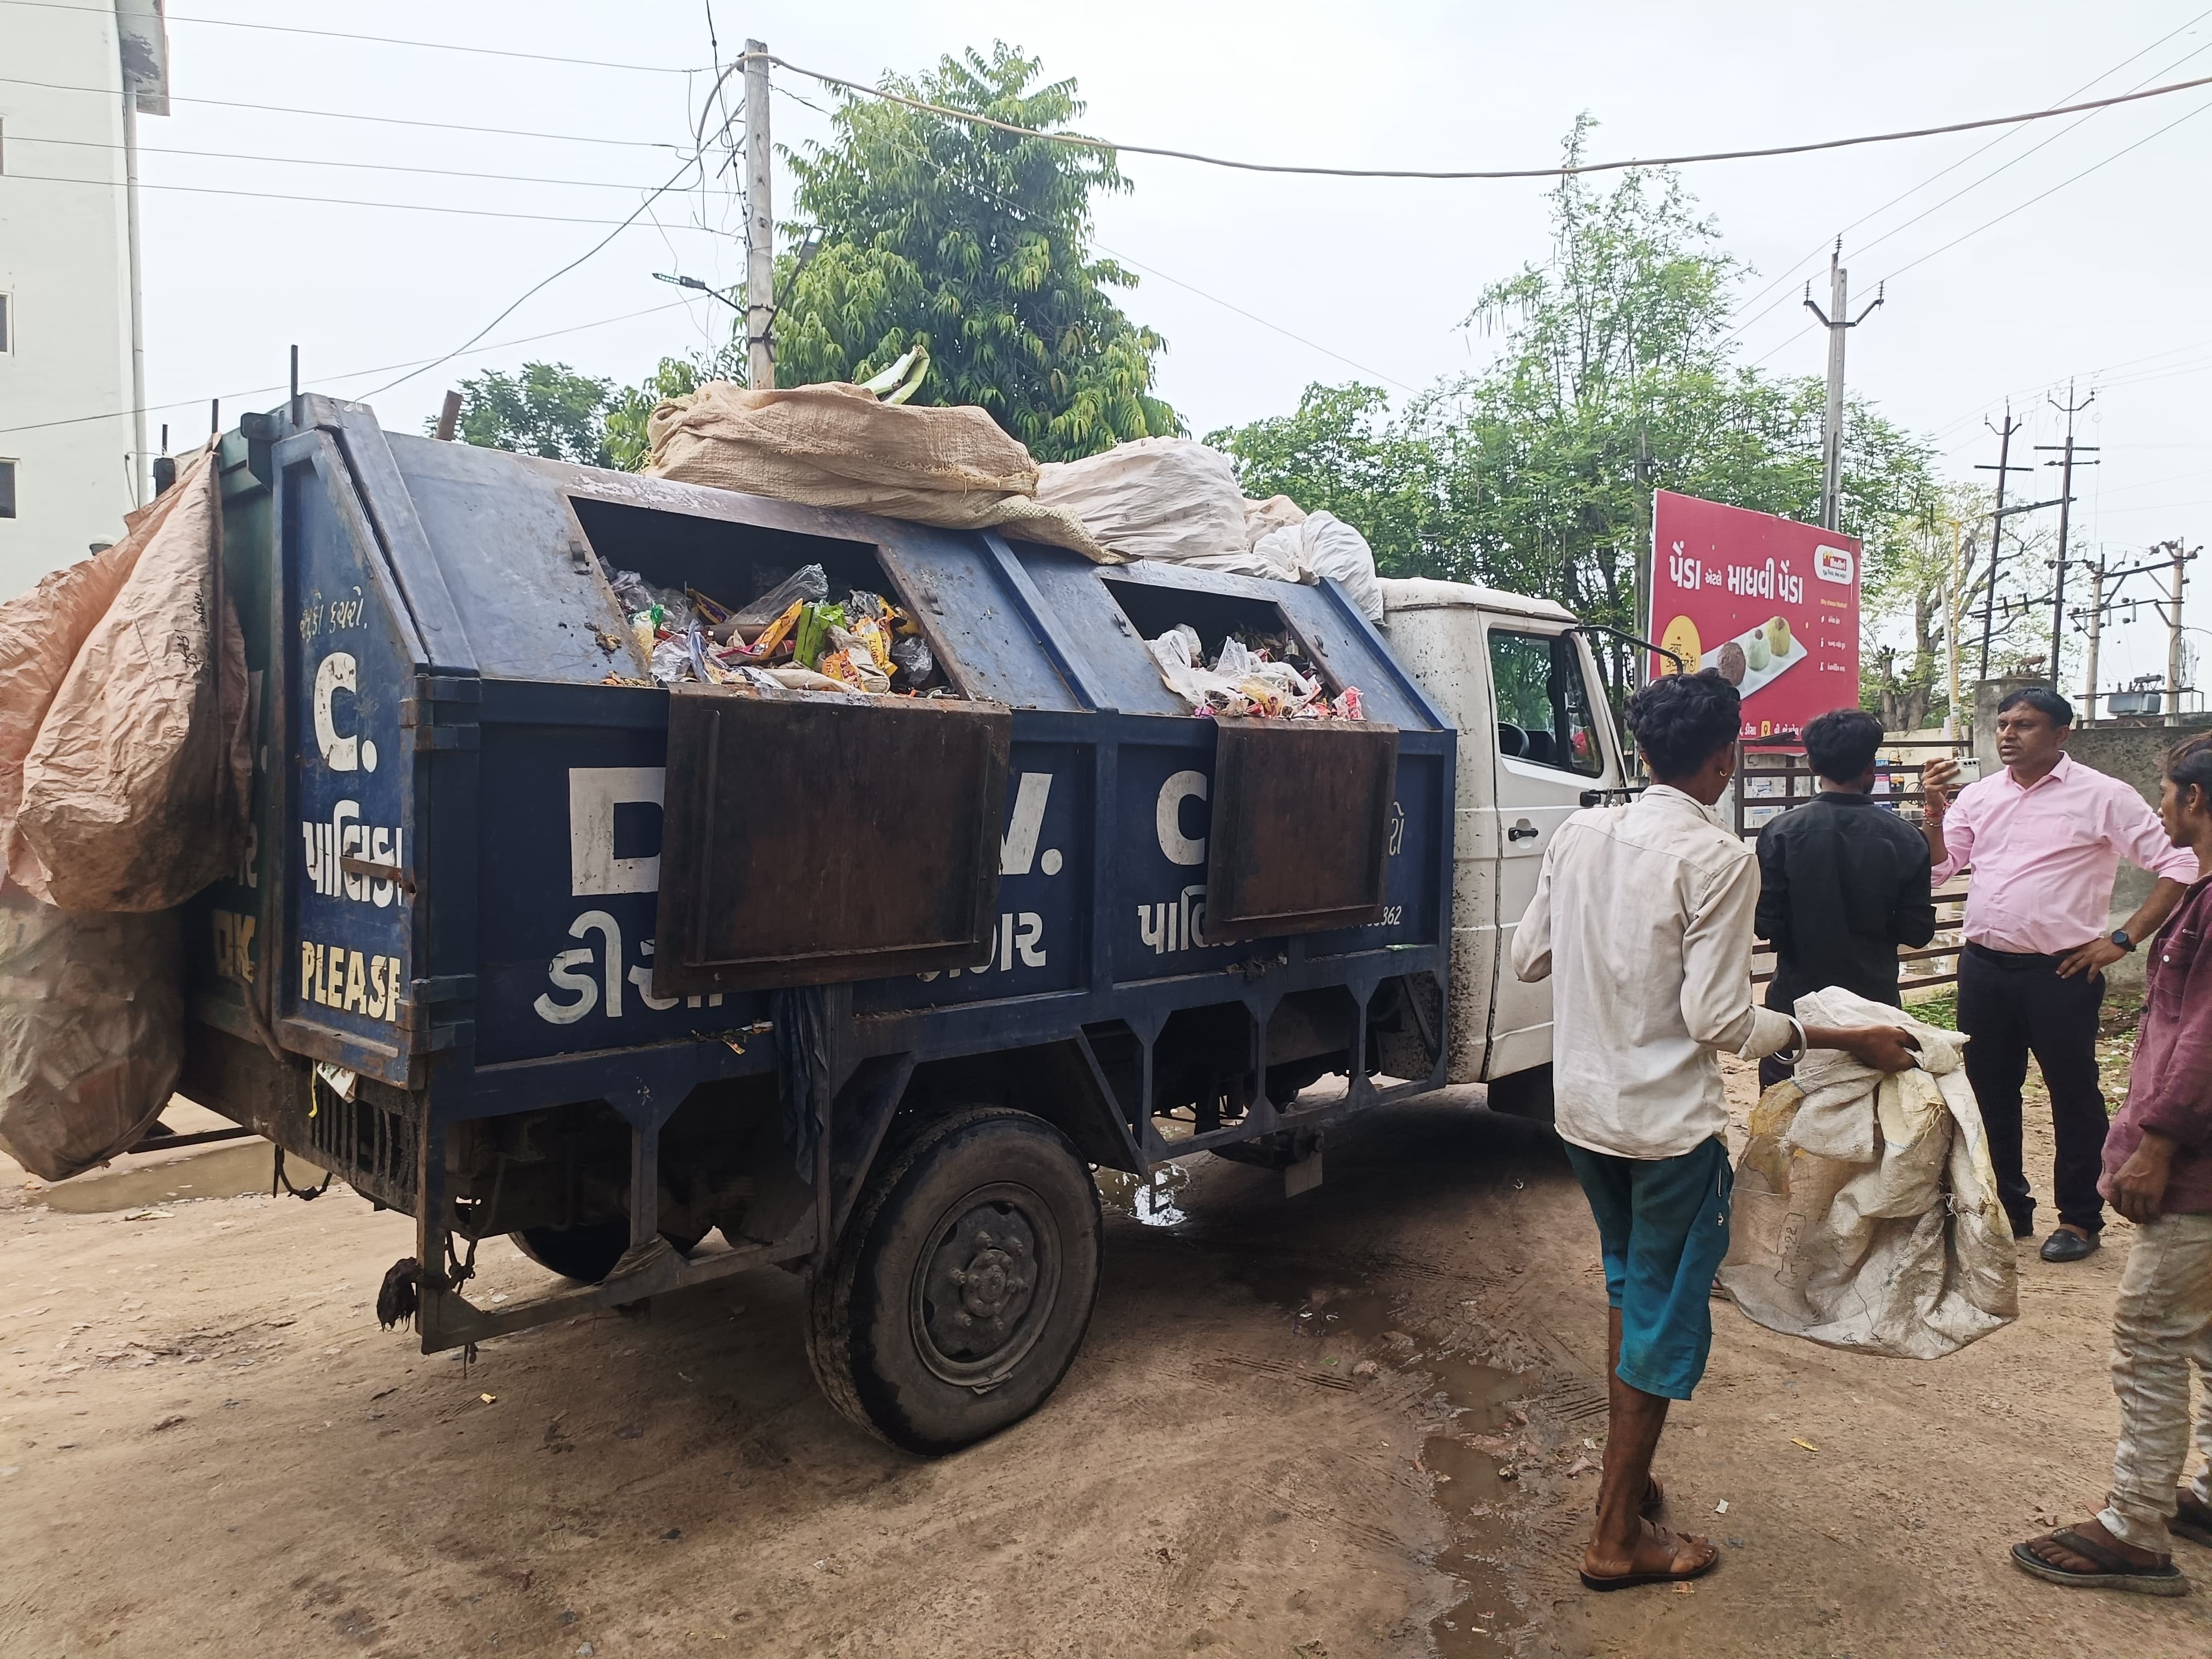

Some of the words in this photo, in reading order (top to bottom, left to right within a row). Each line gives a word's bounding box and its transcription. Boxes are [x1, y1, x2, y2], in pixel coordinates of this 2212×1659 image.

[1669, 541, 1701, 590] પેંડા
[1705, 568, 1722, 586] એટલે
[1728, 557, 1775, 600] માધવી
[1778, 559, 1803, 604] પેંડા
